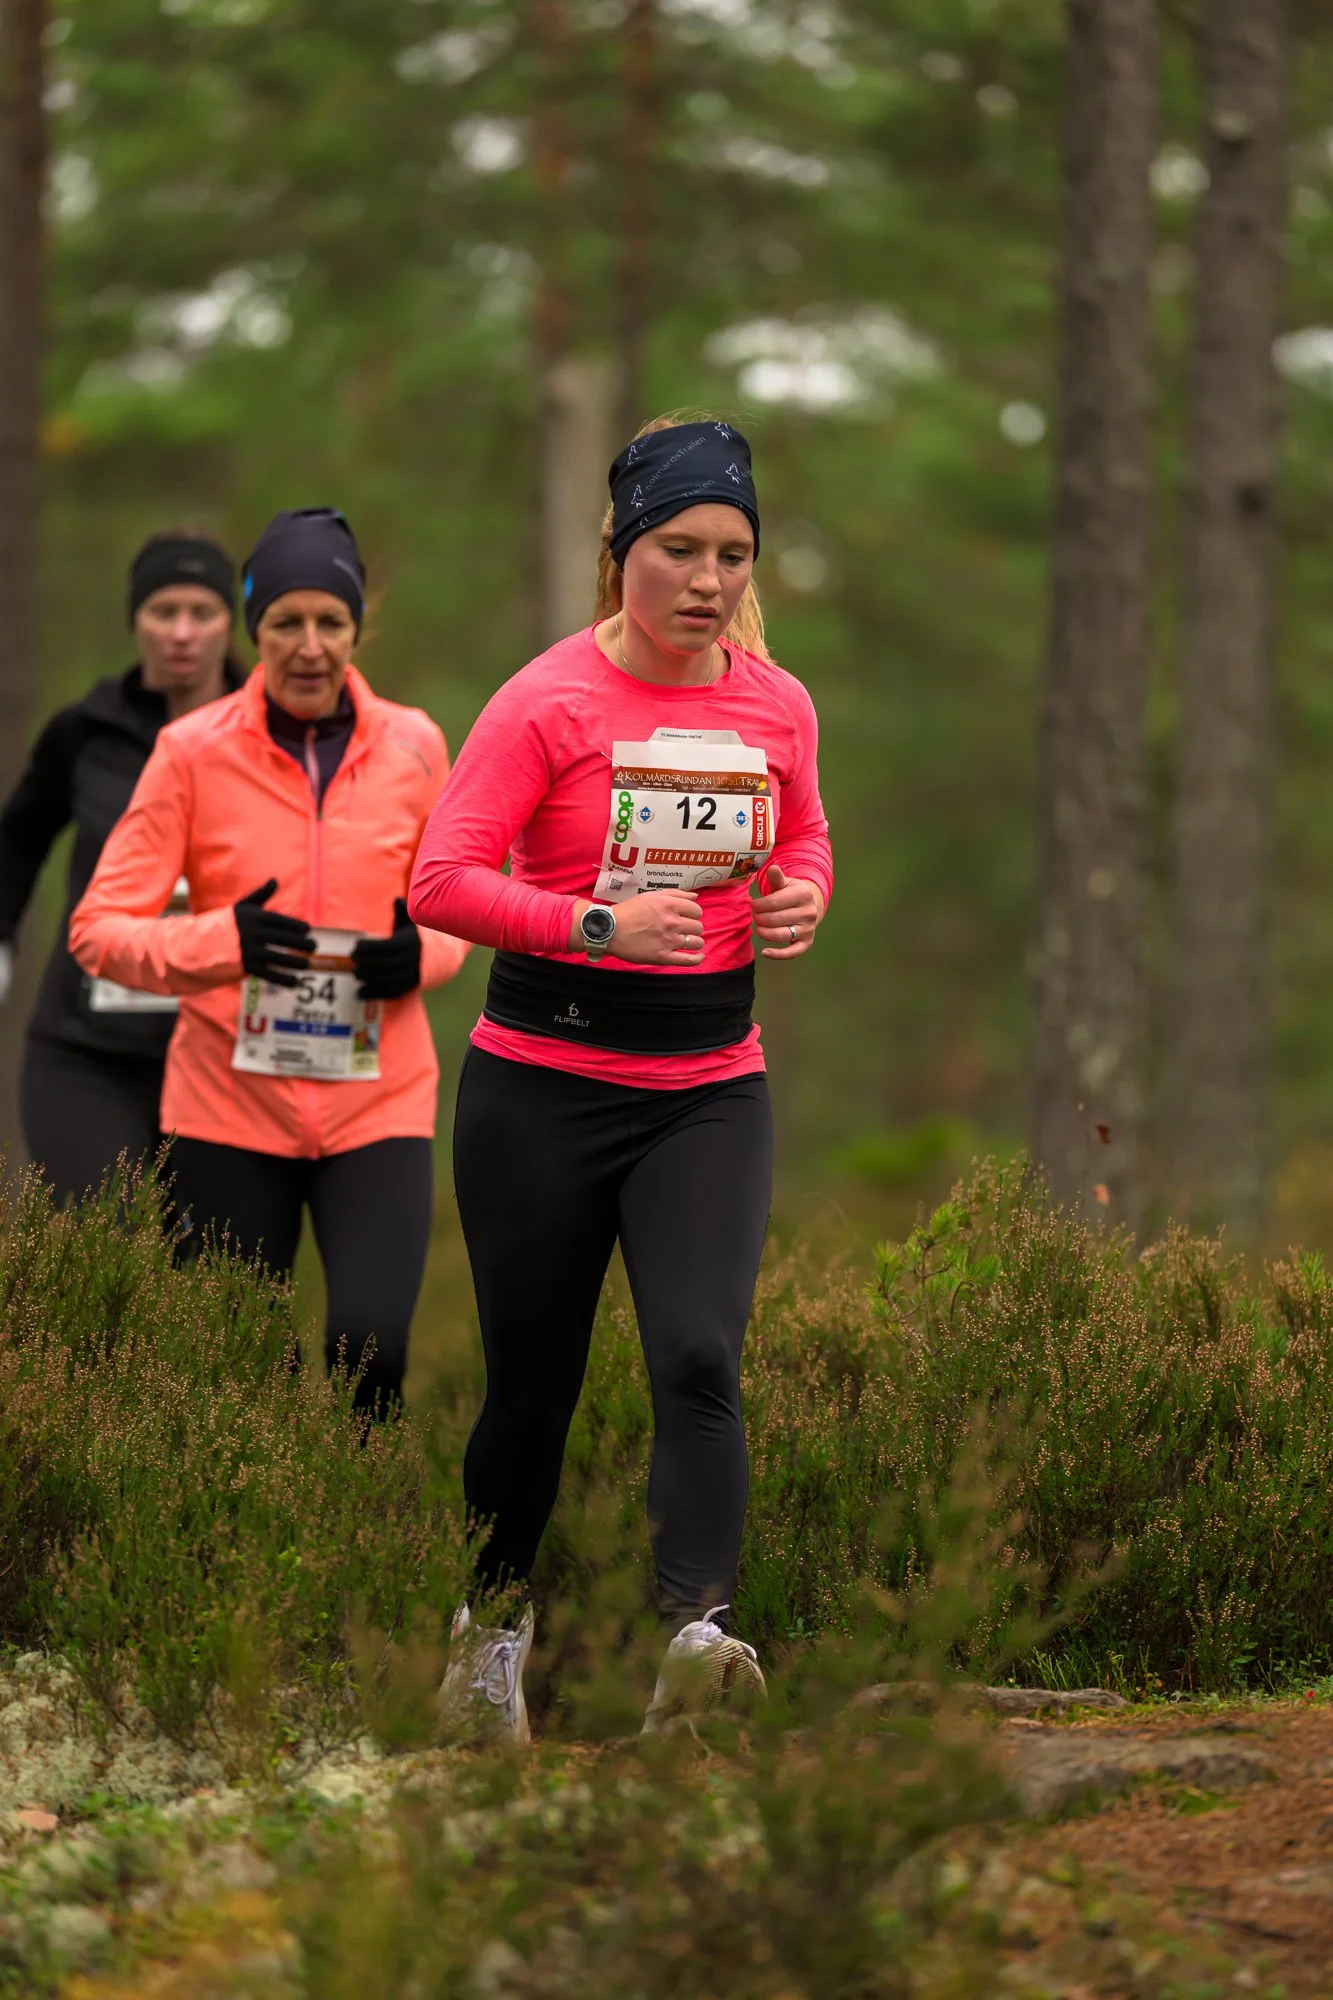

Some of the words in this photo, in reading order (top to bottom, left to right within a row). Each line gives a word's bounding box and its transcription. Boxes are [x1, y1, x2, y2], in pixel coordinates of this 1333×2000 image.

[614, 791, 634, 843] coop
[676, 795, 717, 831] 12
[756, 815, 764, 847] CIRCLE
[646, 851, 733, 863] EFTERANMÄLAN
[296, 976, 337, 1005] 54
[554, 1015, 590, 1027] FLIPBELT
